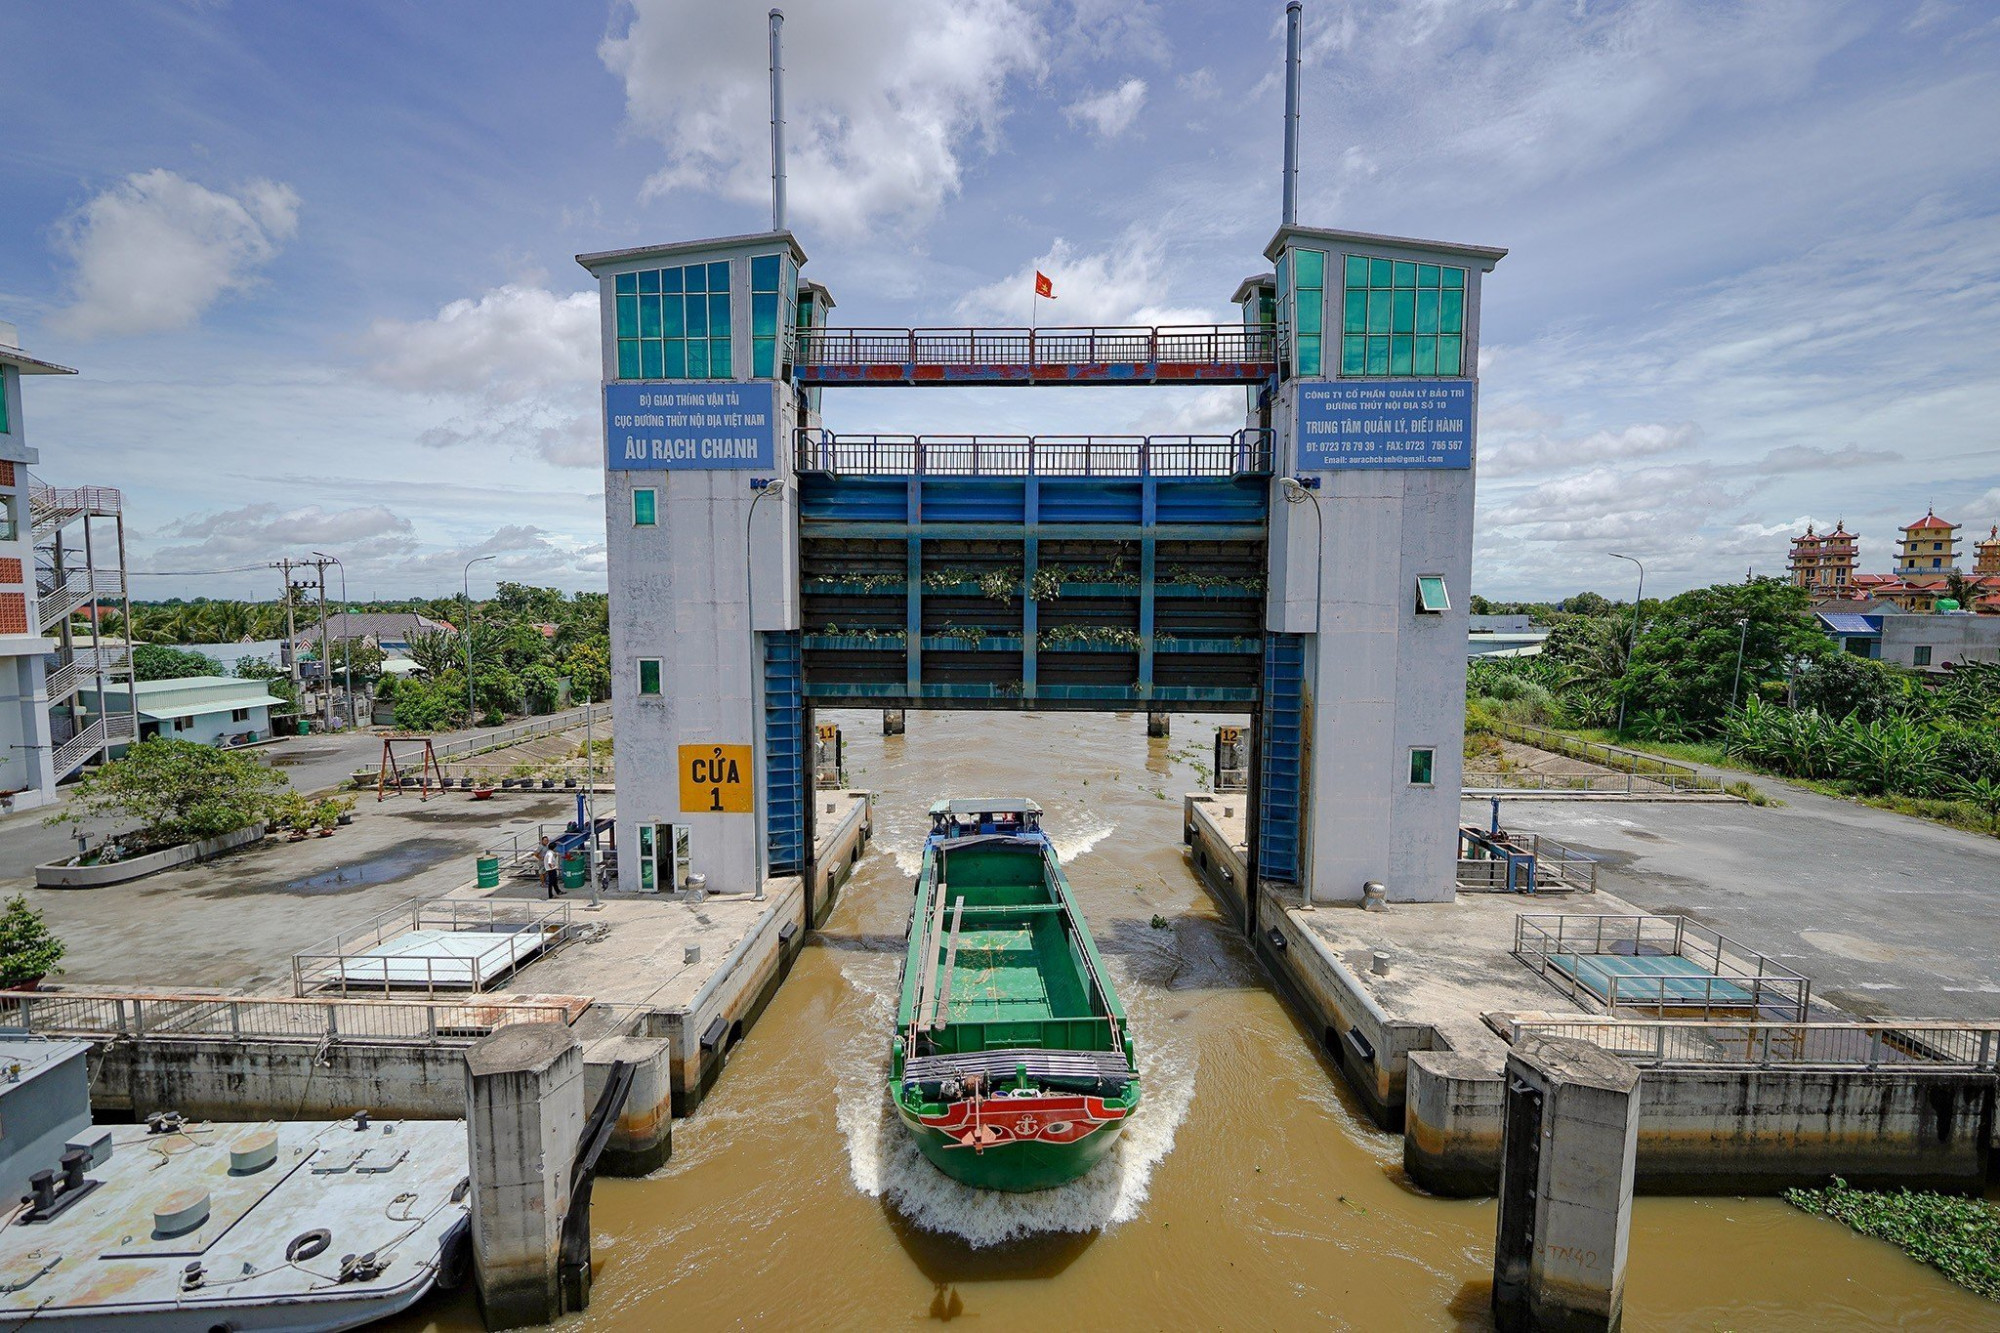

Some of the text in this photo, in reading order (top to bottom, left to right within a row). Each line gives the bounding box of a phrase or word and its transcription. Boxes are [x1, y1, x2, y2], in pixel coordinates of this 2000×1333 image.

[654, 394, 674, 406] GIAO
[706, 392, 724, 408] VẬN
[726, 391, 739, 405] TẢI
[1305, 390, 1330, 399] CÔNG
[1436, 401, 1446, 409] 10
[614, 415, 632, 429] CỤC
[666, 412, 688, 426] THỦY
[690, 413, 705, 428] NỘI
[706, 415, 722, 428] ĐỊA
[724, 413, 742, 428] VIỆT
[744, 414, 765, 426] NAM
[1306, 416, 1463, 434] TRUNG TÂM QUẢN LÝ, ĐIỀU HÀNH
[625, 435, 758, 462] ÂU RẠCH CHANH
[1306, 442, 1318, 452] ĐT:
[1319, 442, 1339, 452] 0723
[1341, 442, 1351, 451] 78
[1353, 441, 1363, 451] 79
[1364, 441, 1375, 451] 39
[1386, 441, 1403, 451] FAX:
[1405, 441, 1425, 451] 0723
[1448, 441, 1462, 450] 567
[820, 726, 834, 739] 11
[1223, 730, 1238, 741] 12
[692, 747, 740, 783] CỬA
[710, 787, 724, 811] 1
